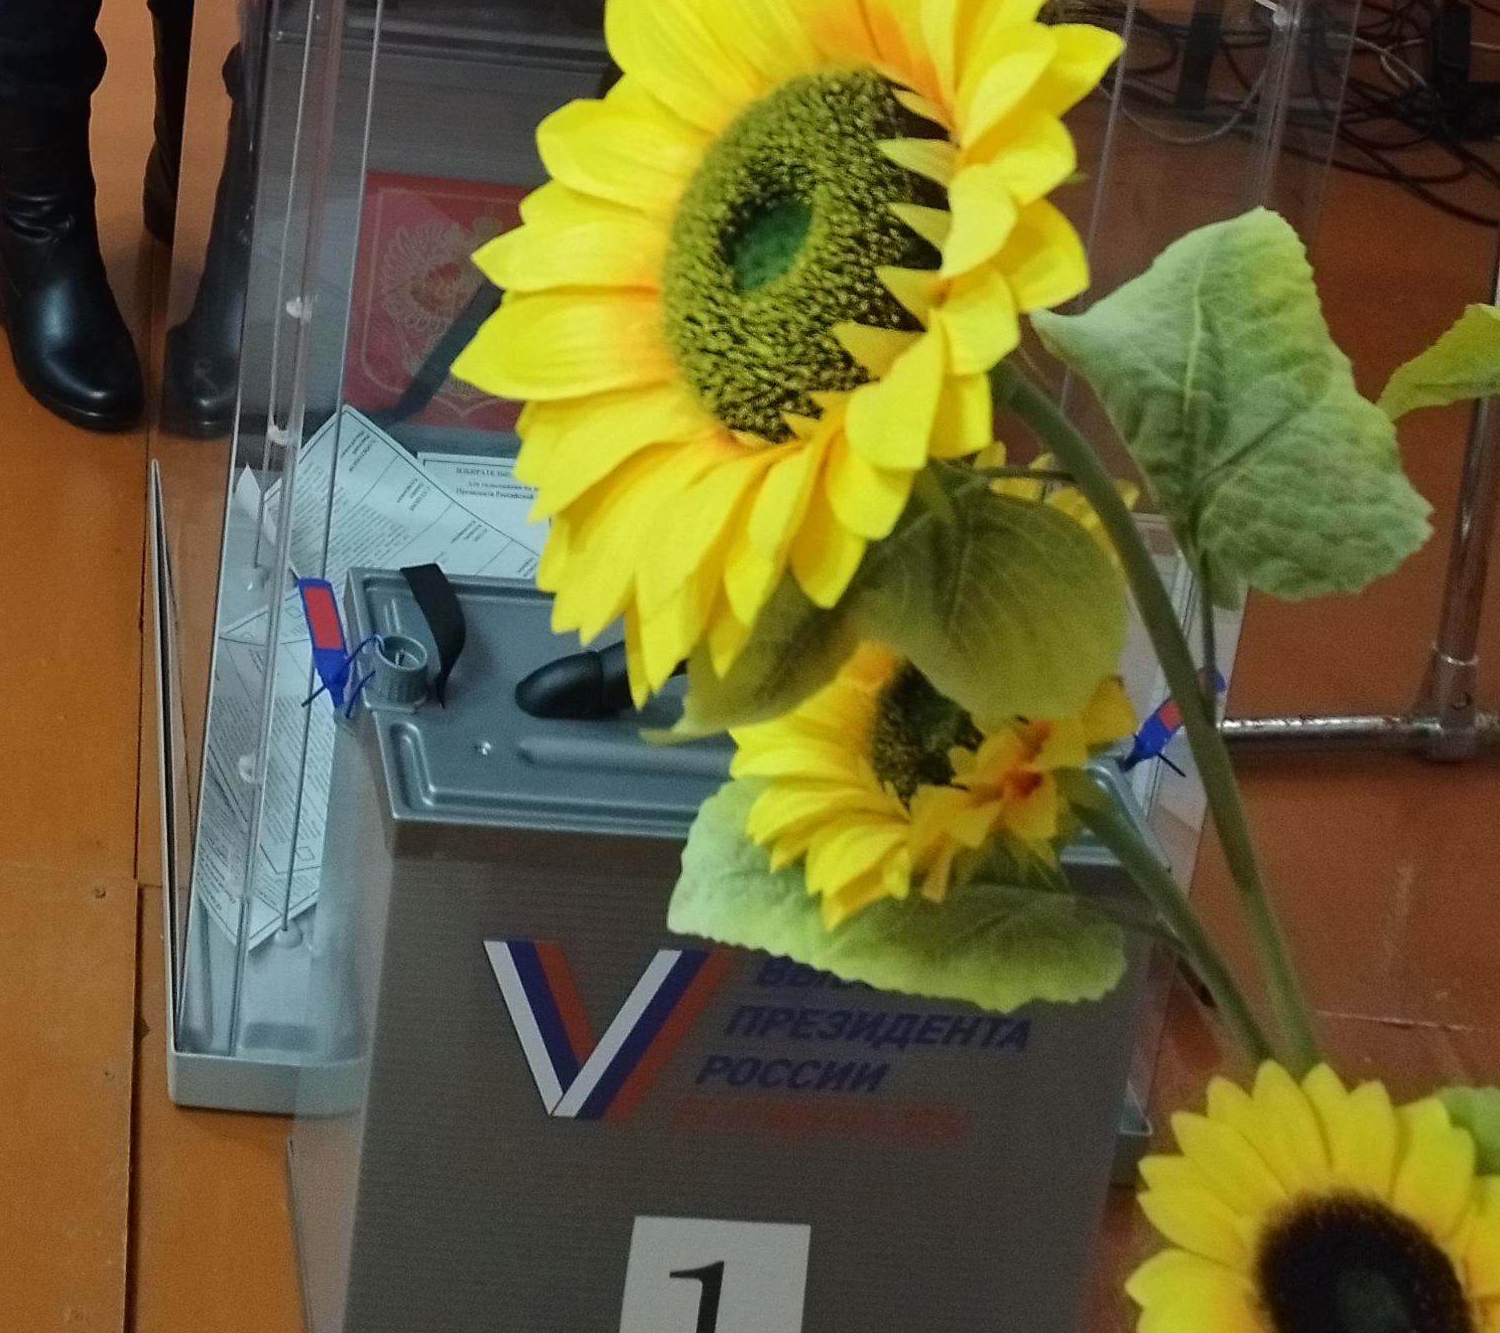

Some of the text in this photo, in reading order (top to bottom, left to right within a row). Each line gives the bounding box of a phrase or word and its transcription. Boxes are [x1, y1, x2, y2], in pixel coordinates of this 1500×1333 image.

[726, 1004, 1033, 1051] ПРЕЗИДЕНТА
[696, 1054, 892, 1094] РОССИИ
[669, 1259, 726, 1333] 1
